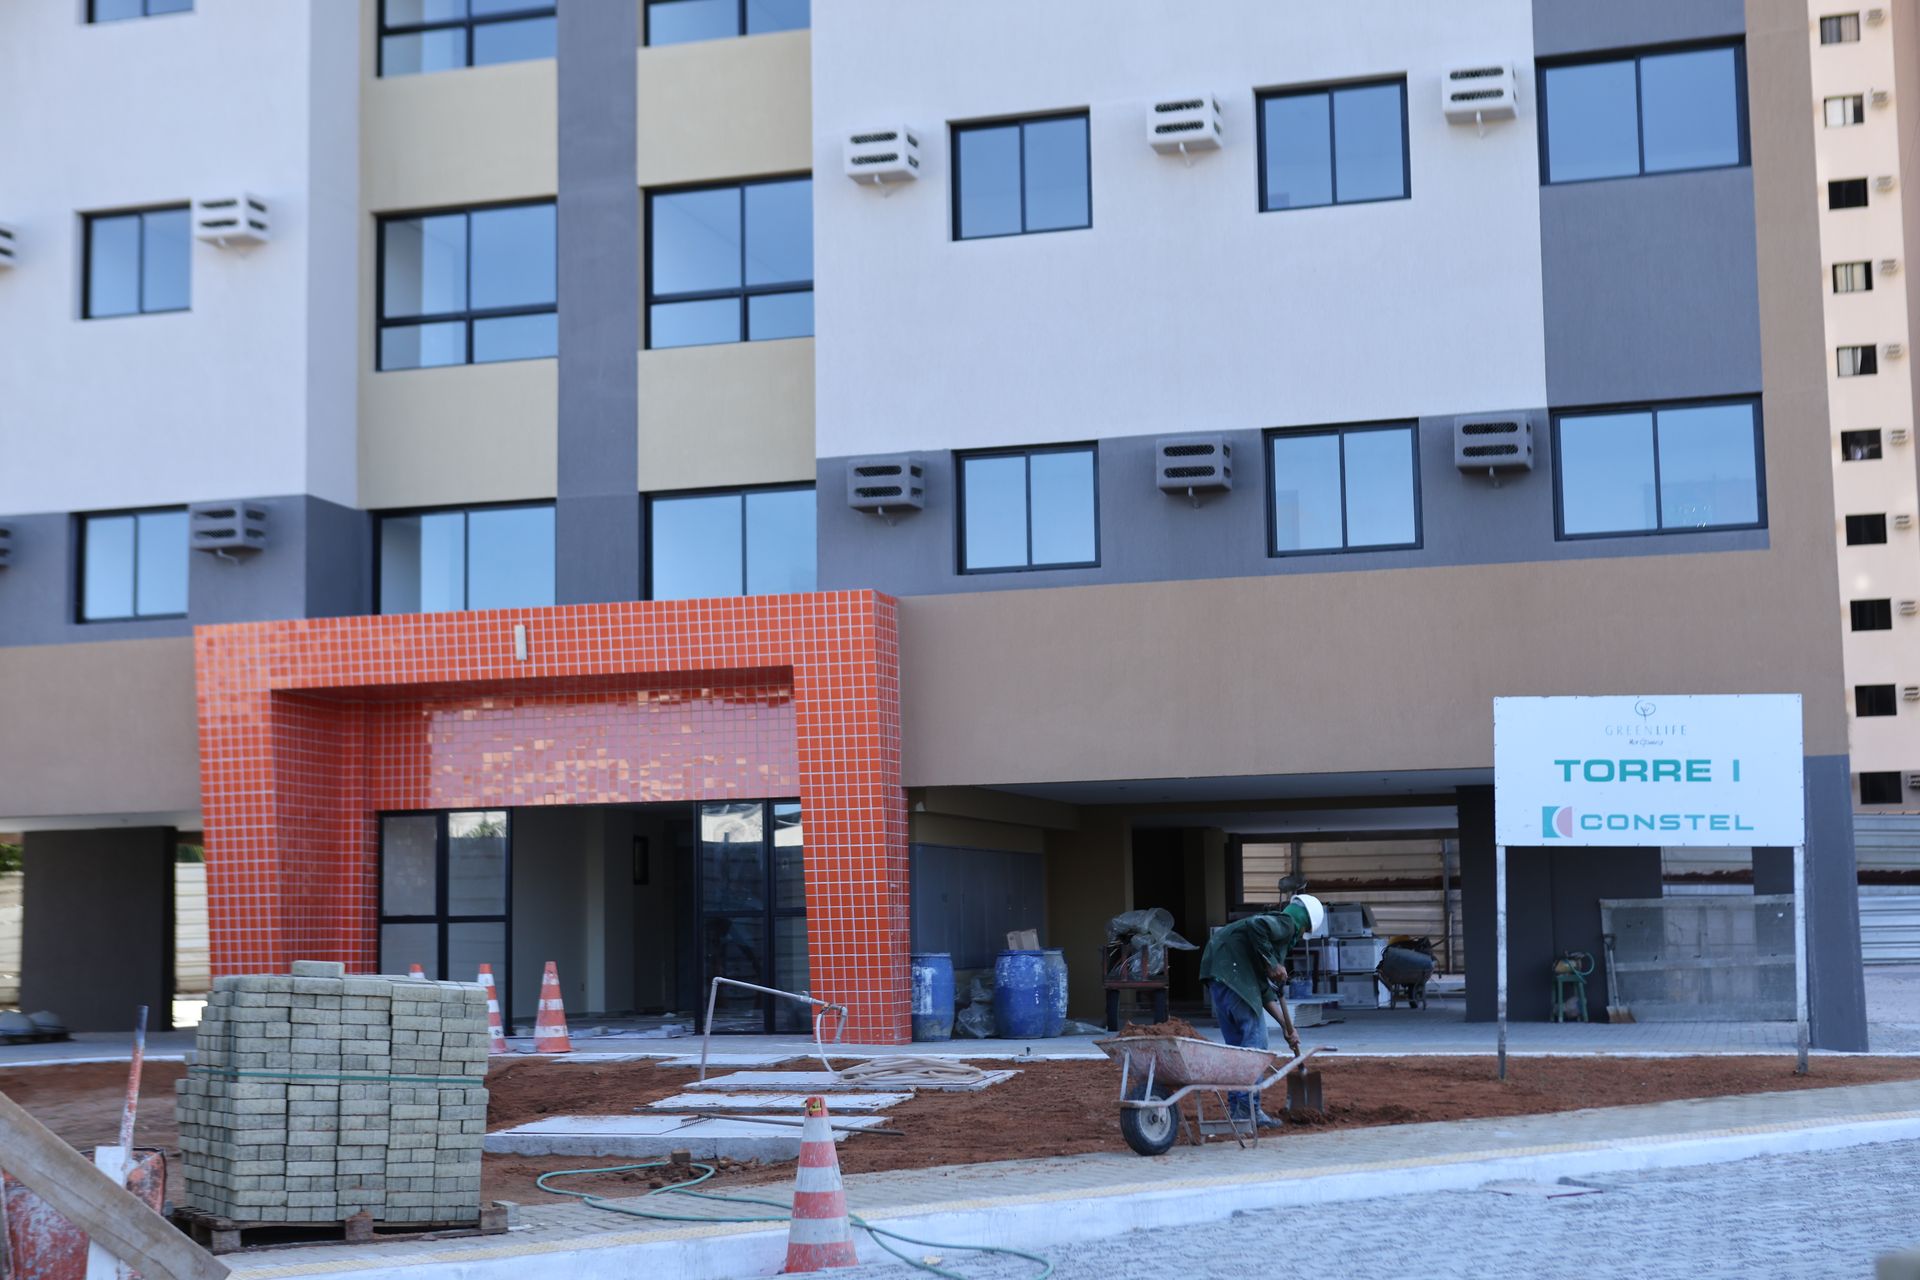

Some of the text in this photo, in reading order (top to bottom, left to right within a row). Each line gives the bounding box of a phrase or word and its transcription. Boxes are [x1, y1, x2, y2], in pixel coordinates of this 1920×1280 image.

[1554, 759, 1740, 783] TORRE I
[1580, 814, 1754, 831] CONSTEL
